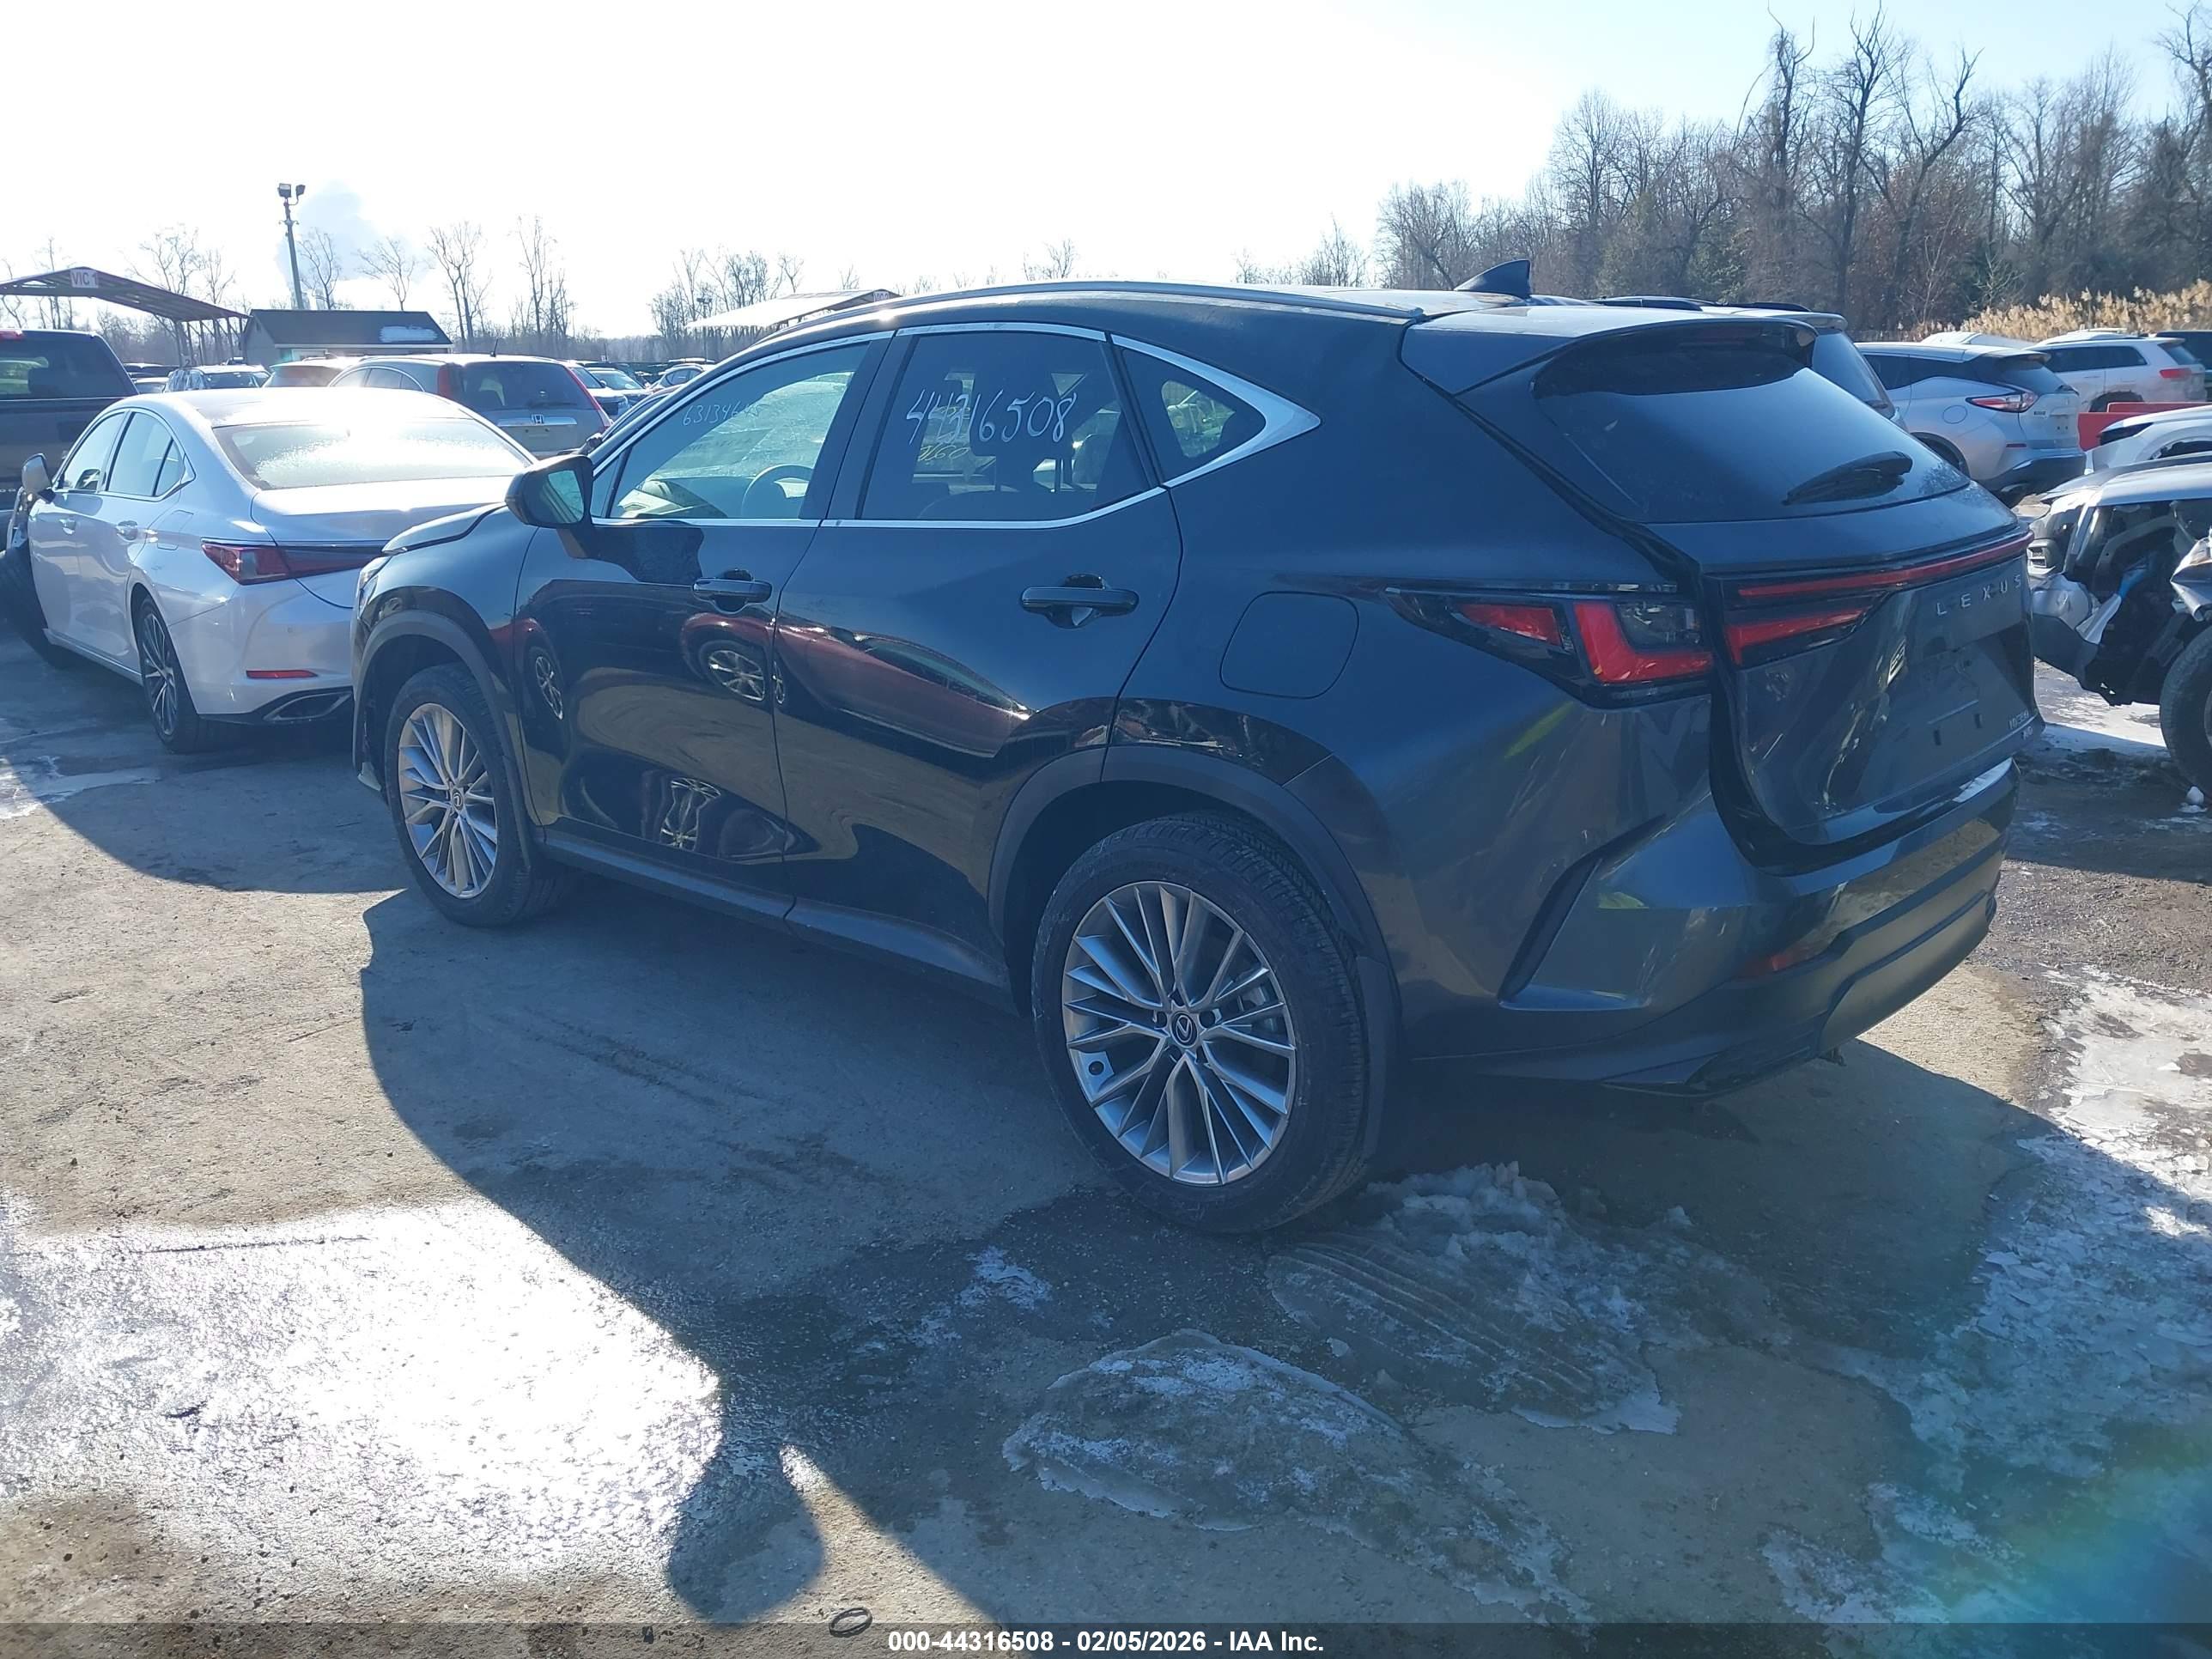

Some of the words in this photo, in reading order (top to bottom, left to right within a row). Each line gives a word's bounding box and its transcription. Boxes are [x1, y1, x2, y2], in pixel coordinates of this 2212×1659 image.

[71, 271, 90, 285] VIC
[906, 388, 1078, 445] 44316508
[1936, 574, 2022, 617] LEXUS
